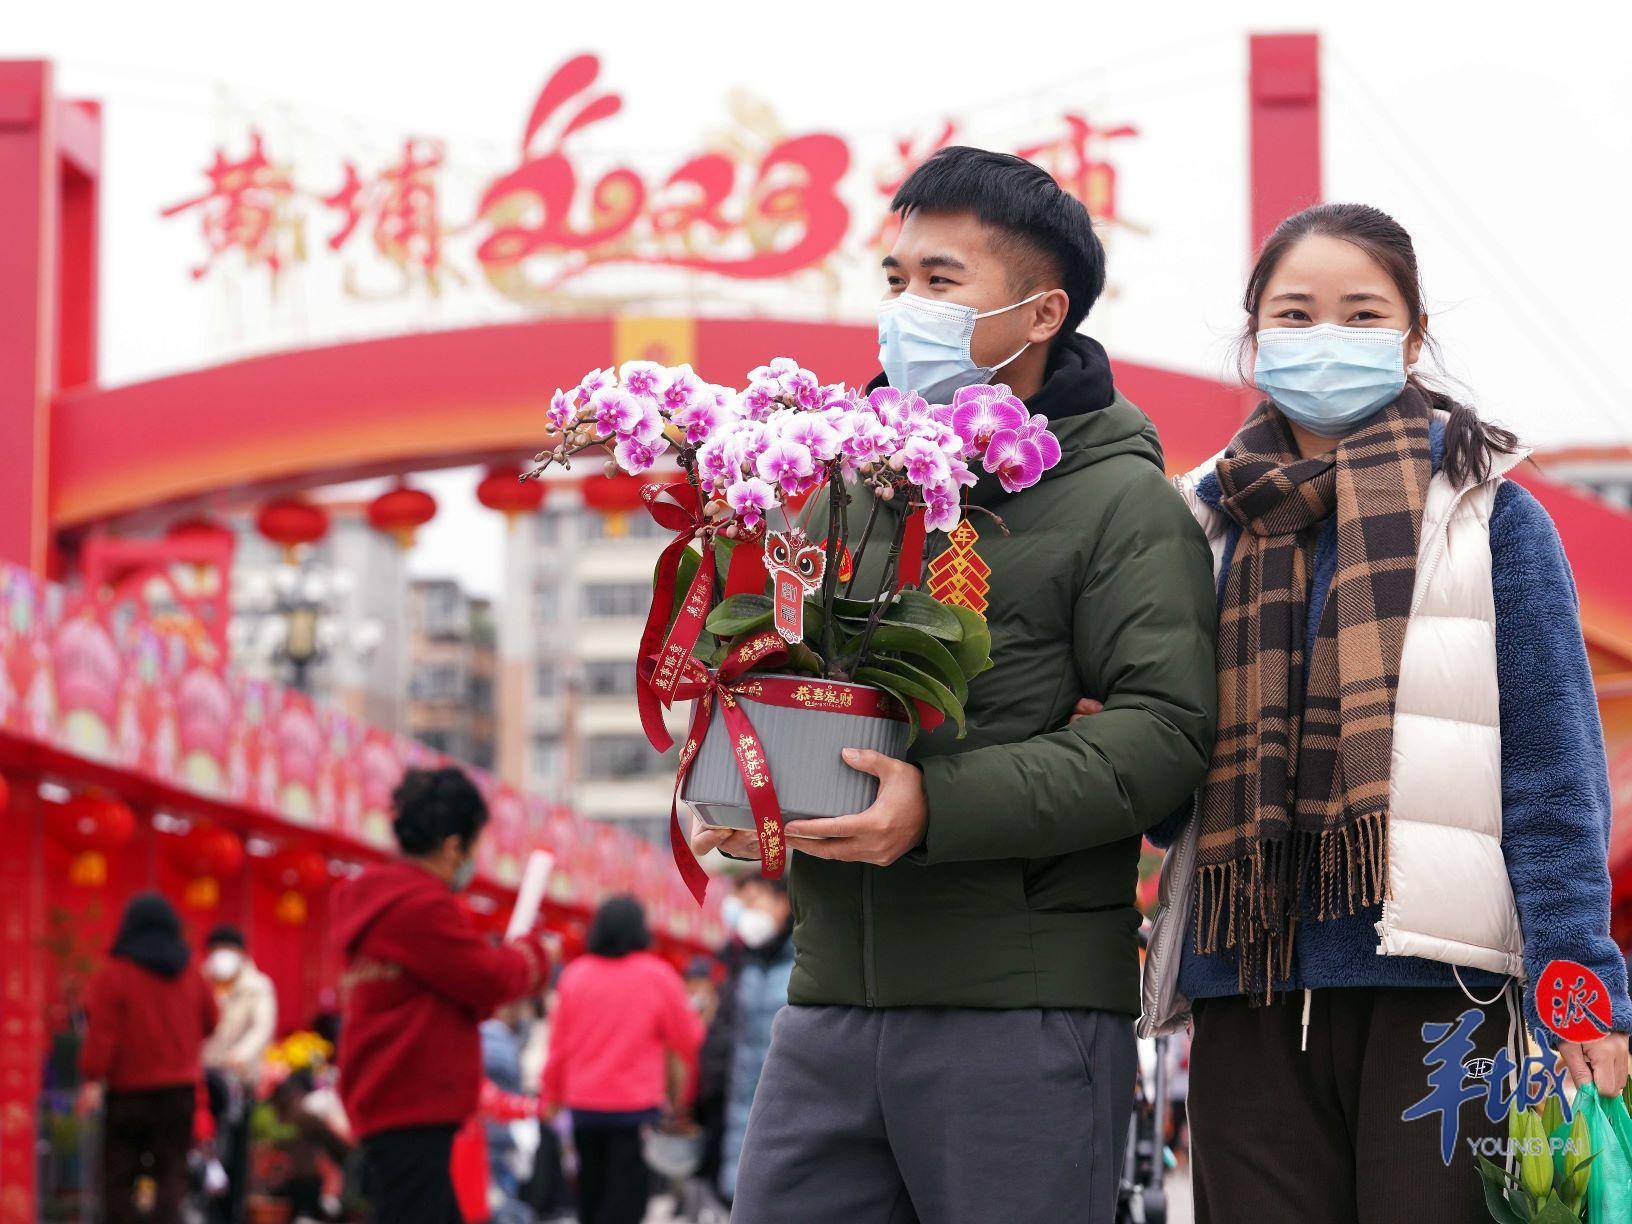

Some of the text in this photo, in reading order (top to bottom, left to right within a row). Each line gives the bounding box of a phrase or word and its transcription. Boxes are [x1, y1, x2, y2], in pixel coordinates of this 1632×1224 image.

[476, 56, 850, 286] 2023
[954, 526, 972, 546] 年
[792, 685, 854, 706] 恭喜发财
[739, 734, 769, 788] 恭喜发财
